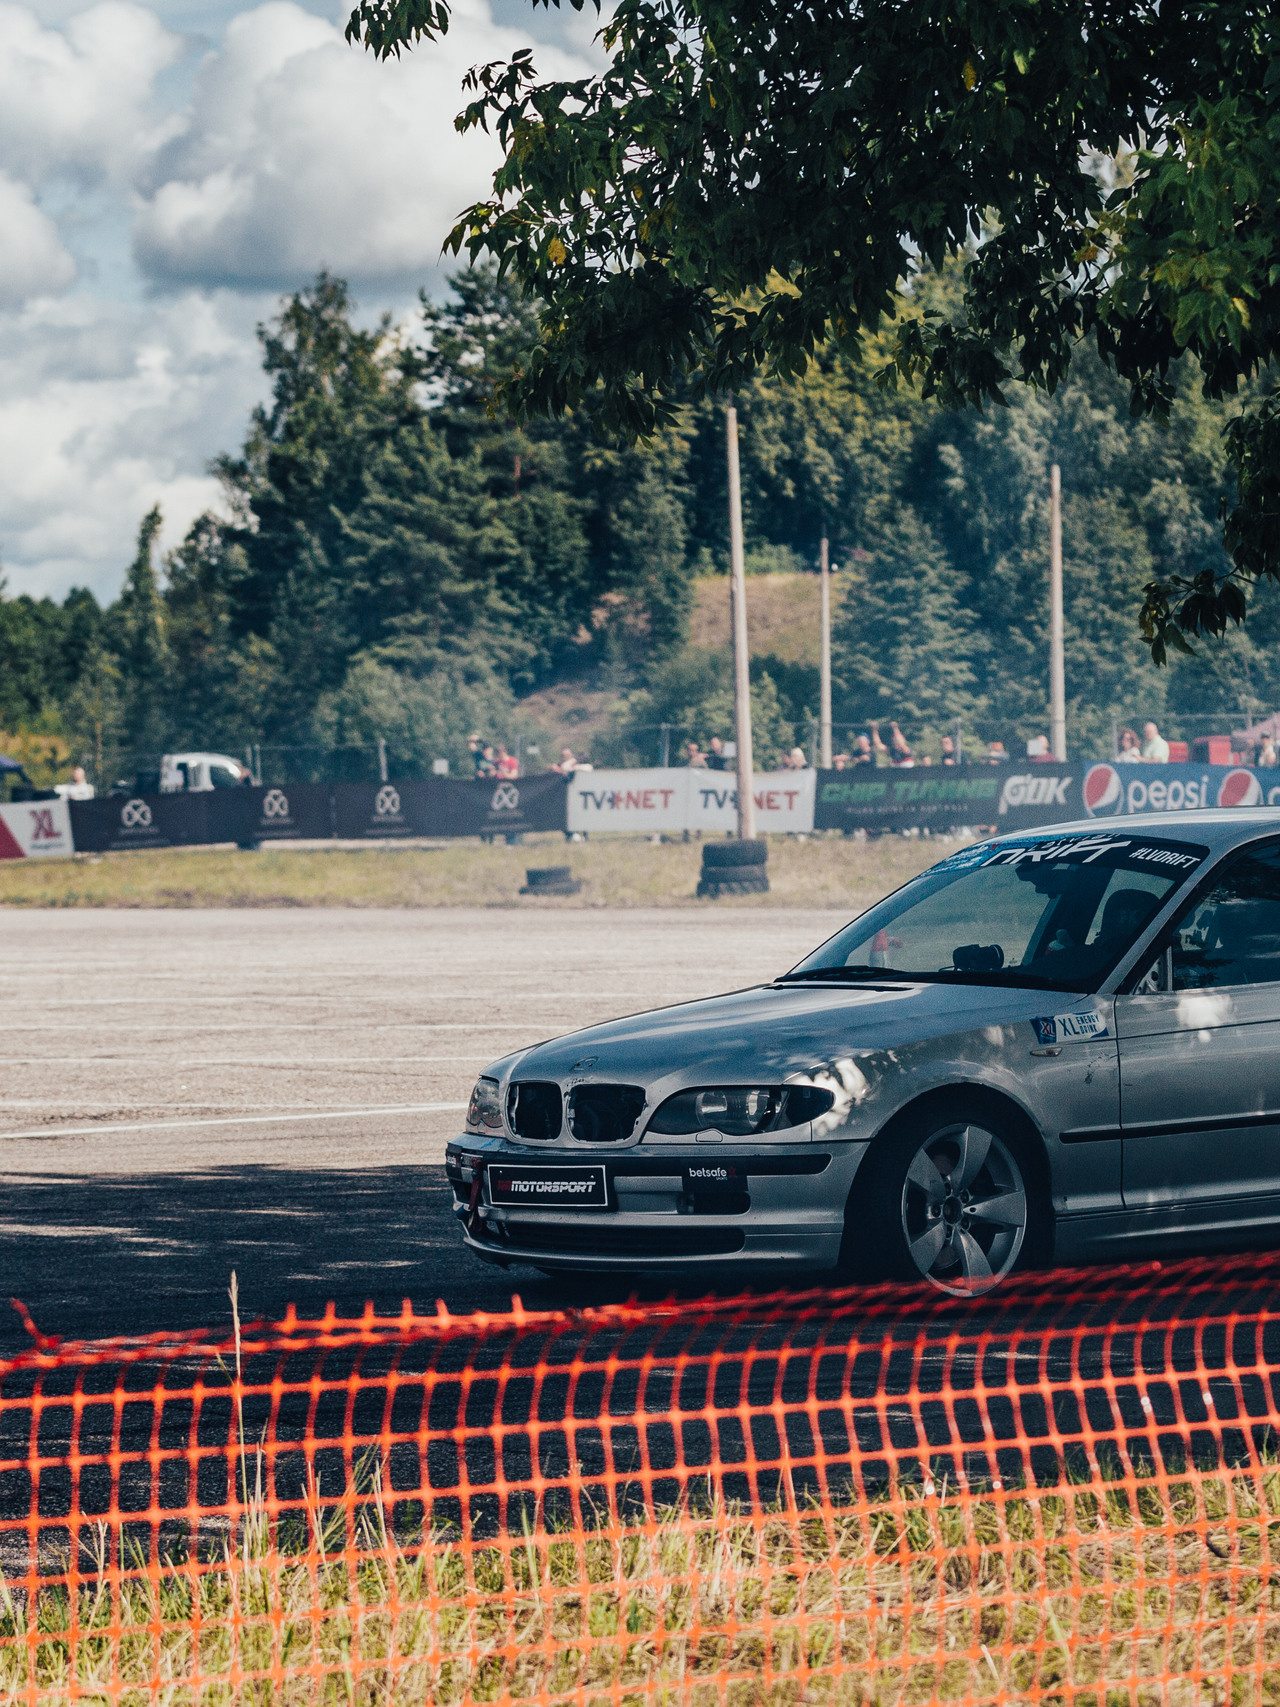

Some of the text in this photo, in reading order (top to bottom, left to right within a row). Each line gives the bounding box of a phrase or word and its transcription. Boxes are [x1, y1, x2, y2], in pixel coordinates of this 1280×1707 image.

[820, 778, 999, 802] CHIP TUNING
[1127, 775, 1209, 815] pepsi
[29, 808, 62, 840] XL
[1129, 847, 1201, 869] #LVDRIFT
[1057, 1017, 1080, 1037] XL
[1076, 1014, 1100, 1025] ENERGY
[1079, 1024, 1099, 1035] DRINK
[688, 1167, 727, 1177] betsafe
